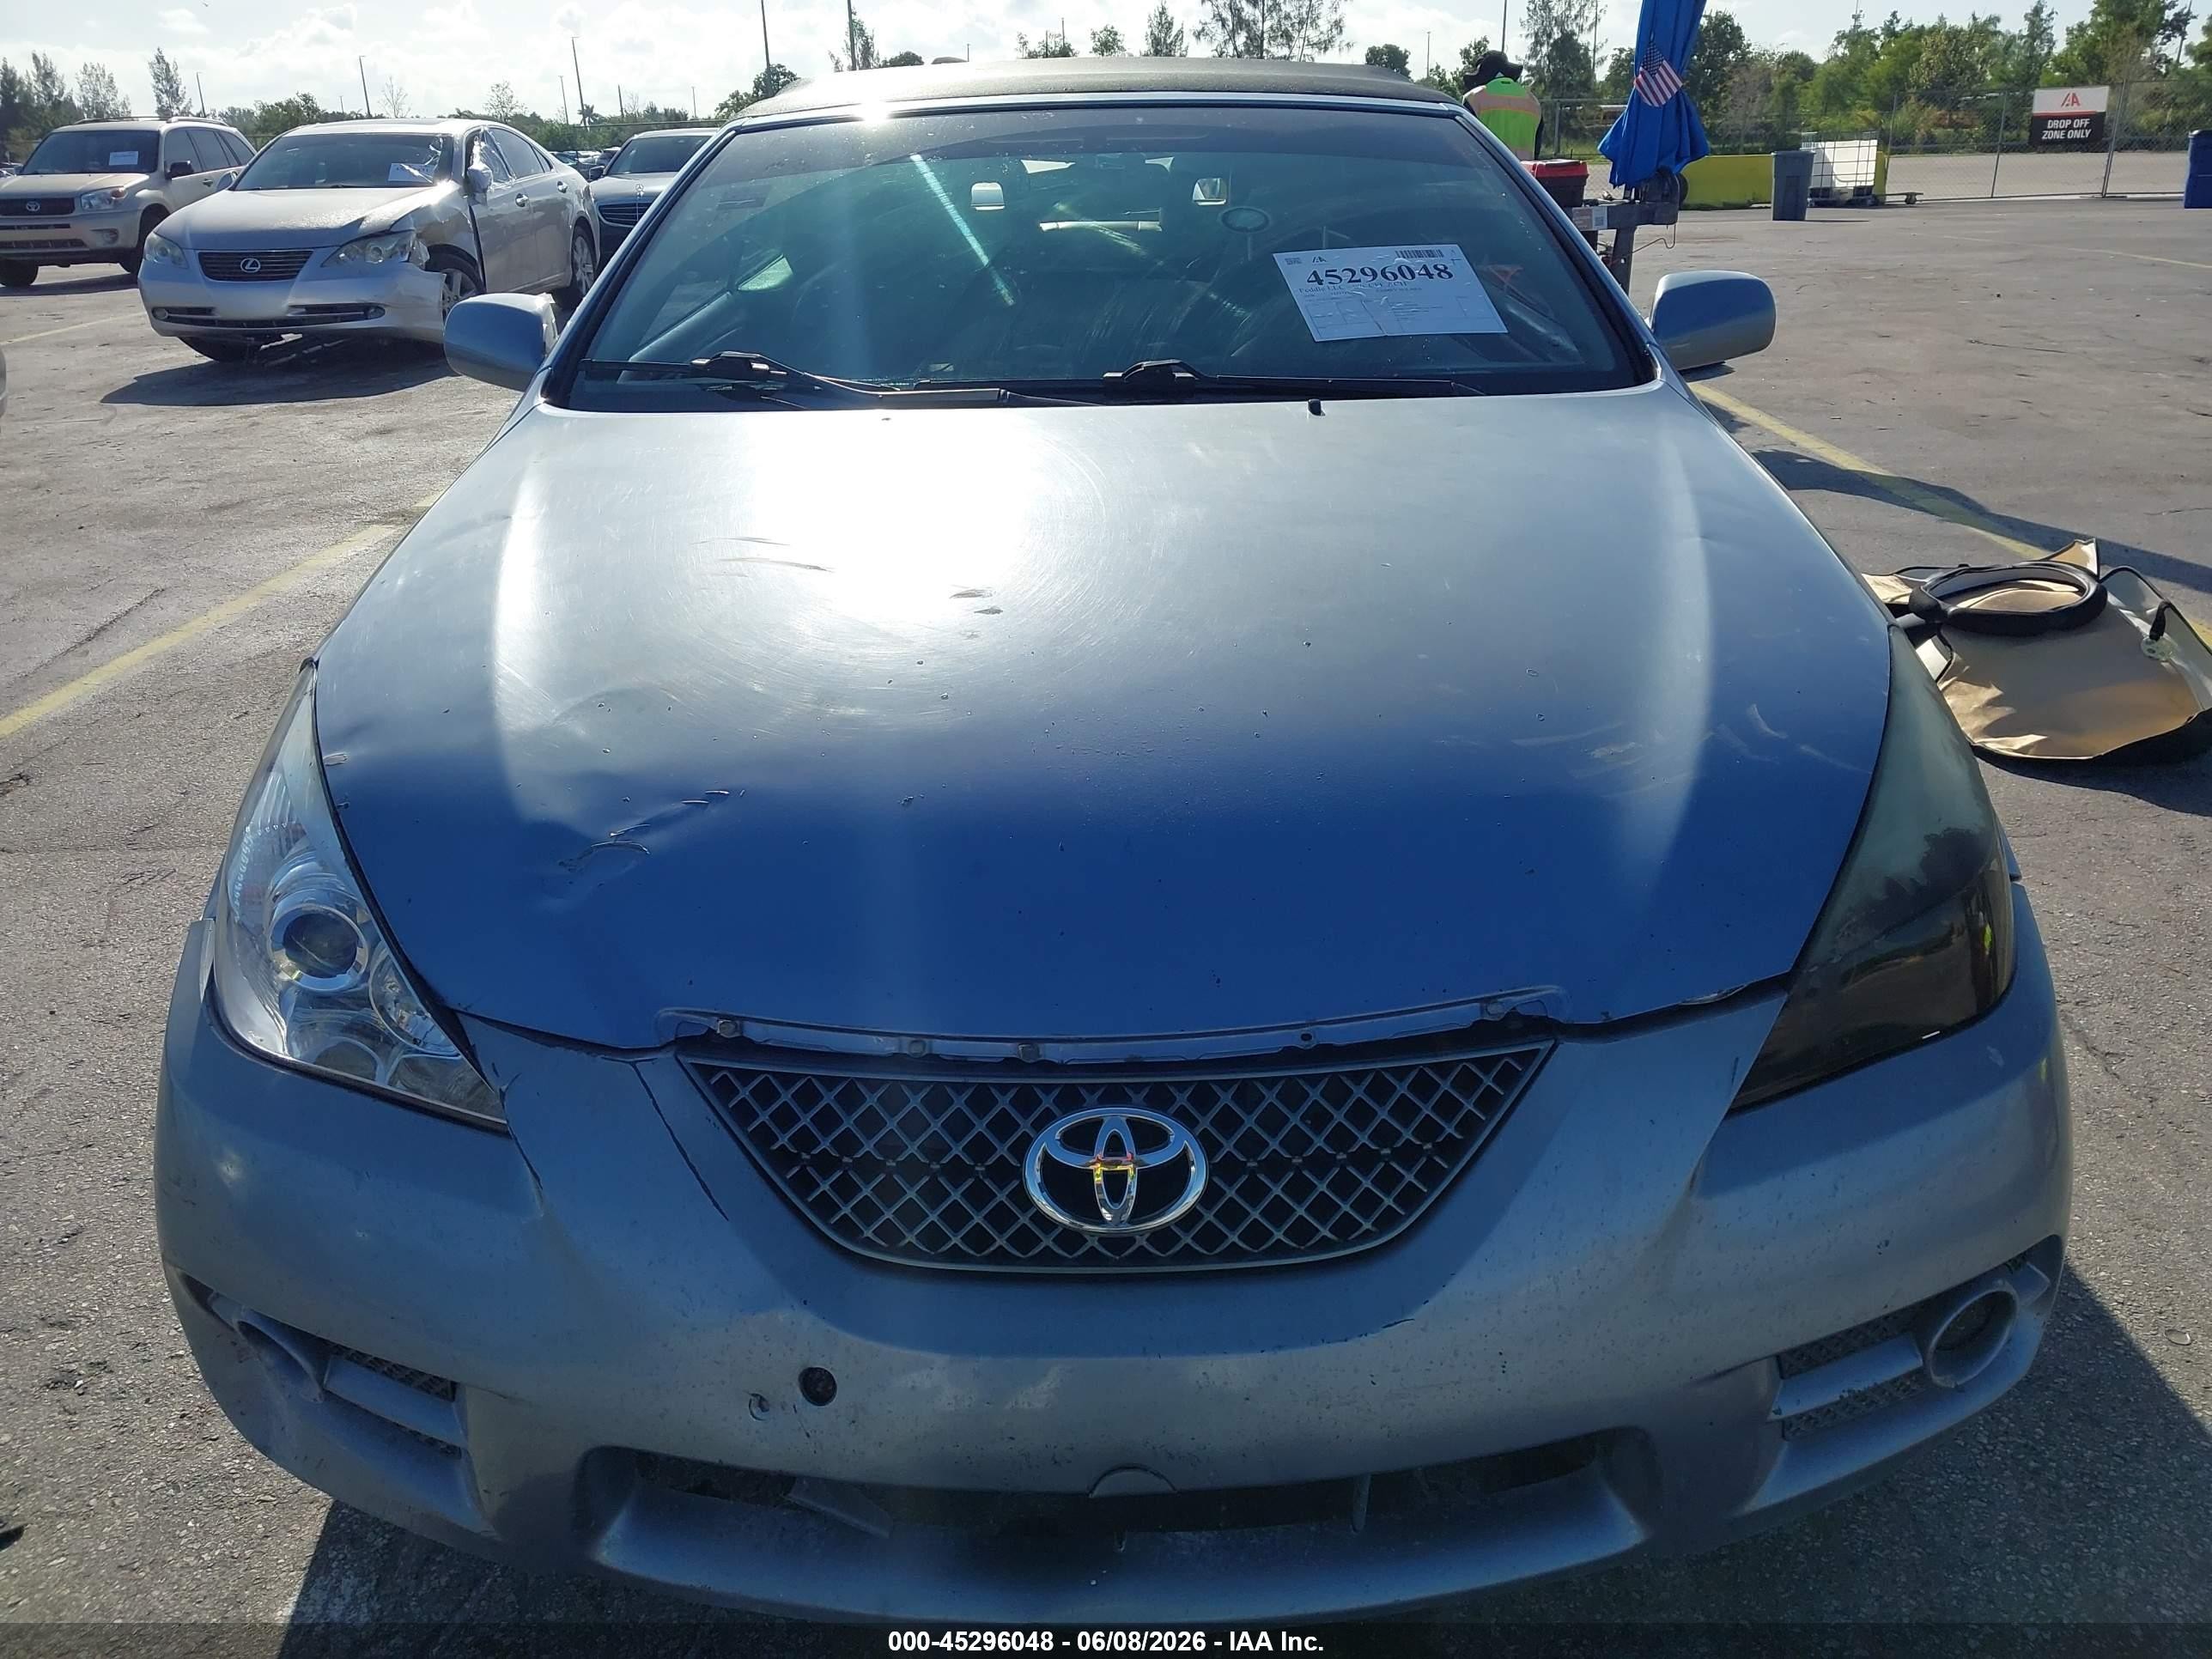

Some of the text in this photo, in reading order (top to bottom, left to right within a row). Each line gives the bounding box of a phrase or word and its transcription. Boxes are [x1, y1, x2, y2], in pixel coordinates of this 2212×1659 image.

[2047, 118, 2090, 129] DROP OFF
[2042, 129, 2092, 139] ZONE ONLY
[1306, 263, 1454, 286] 45296048
